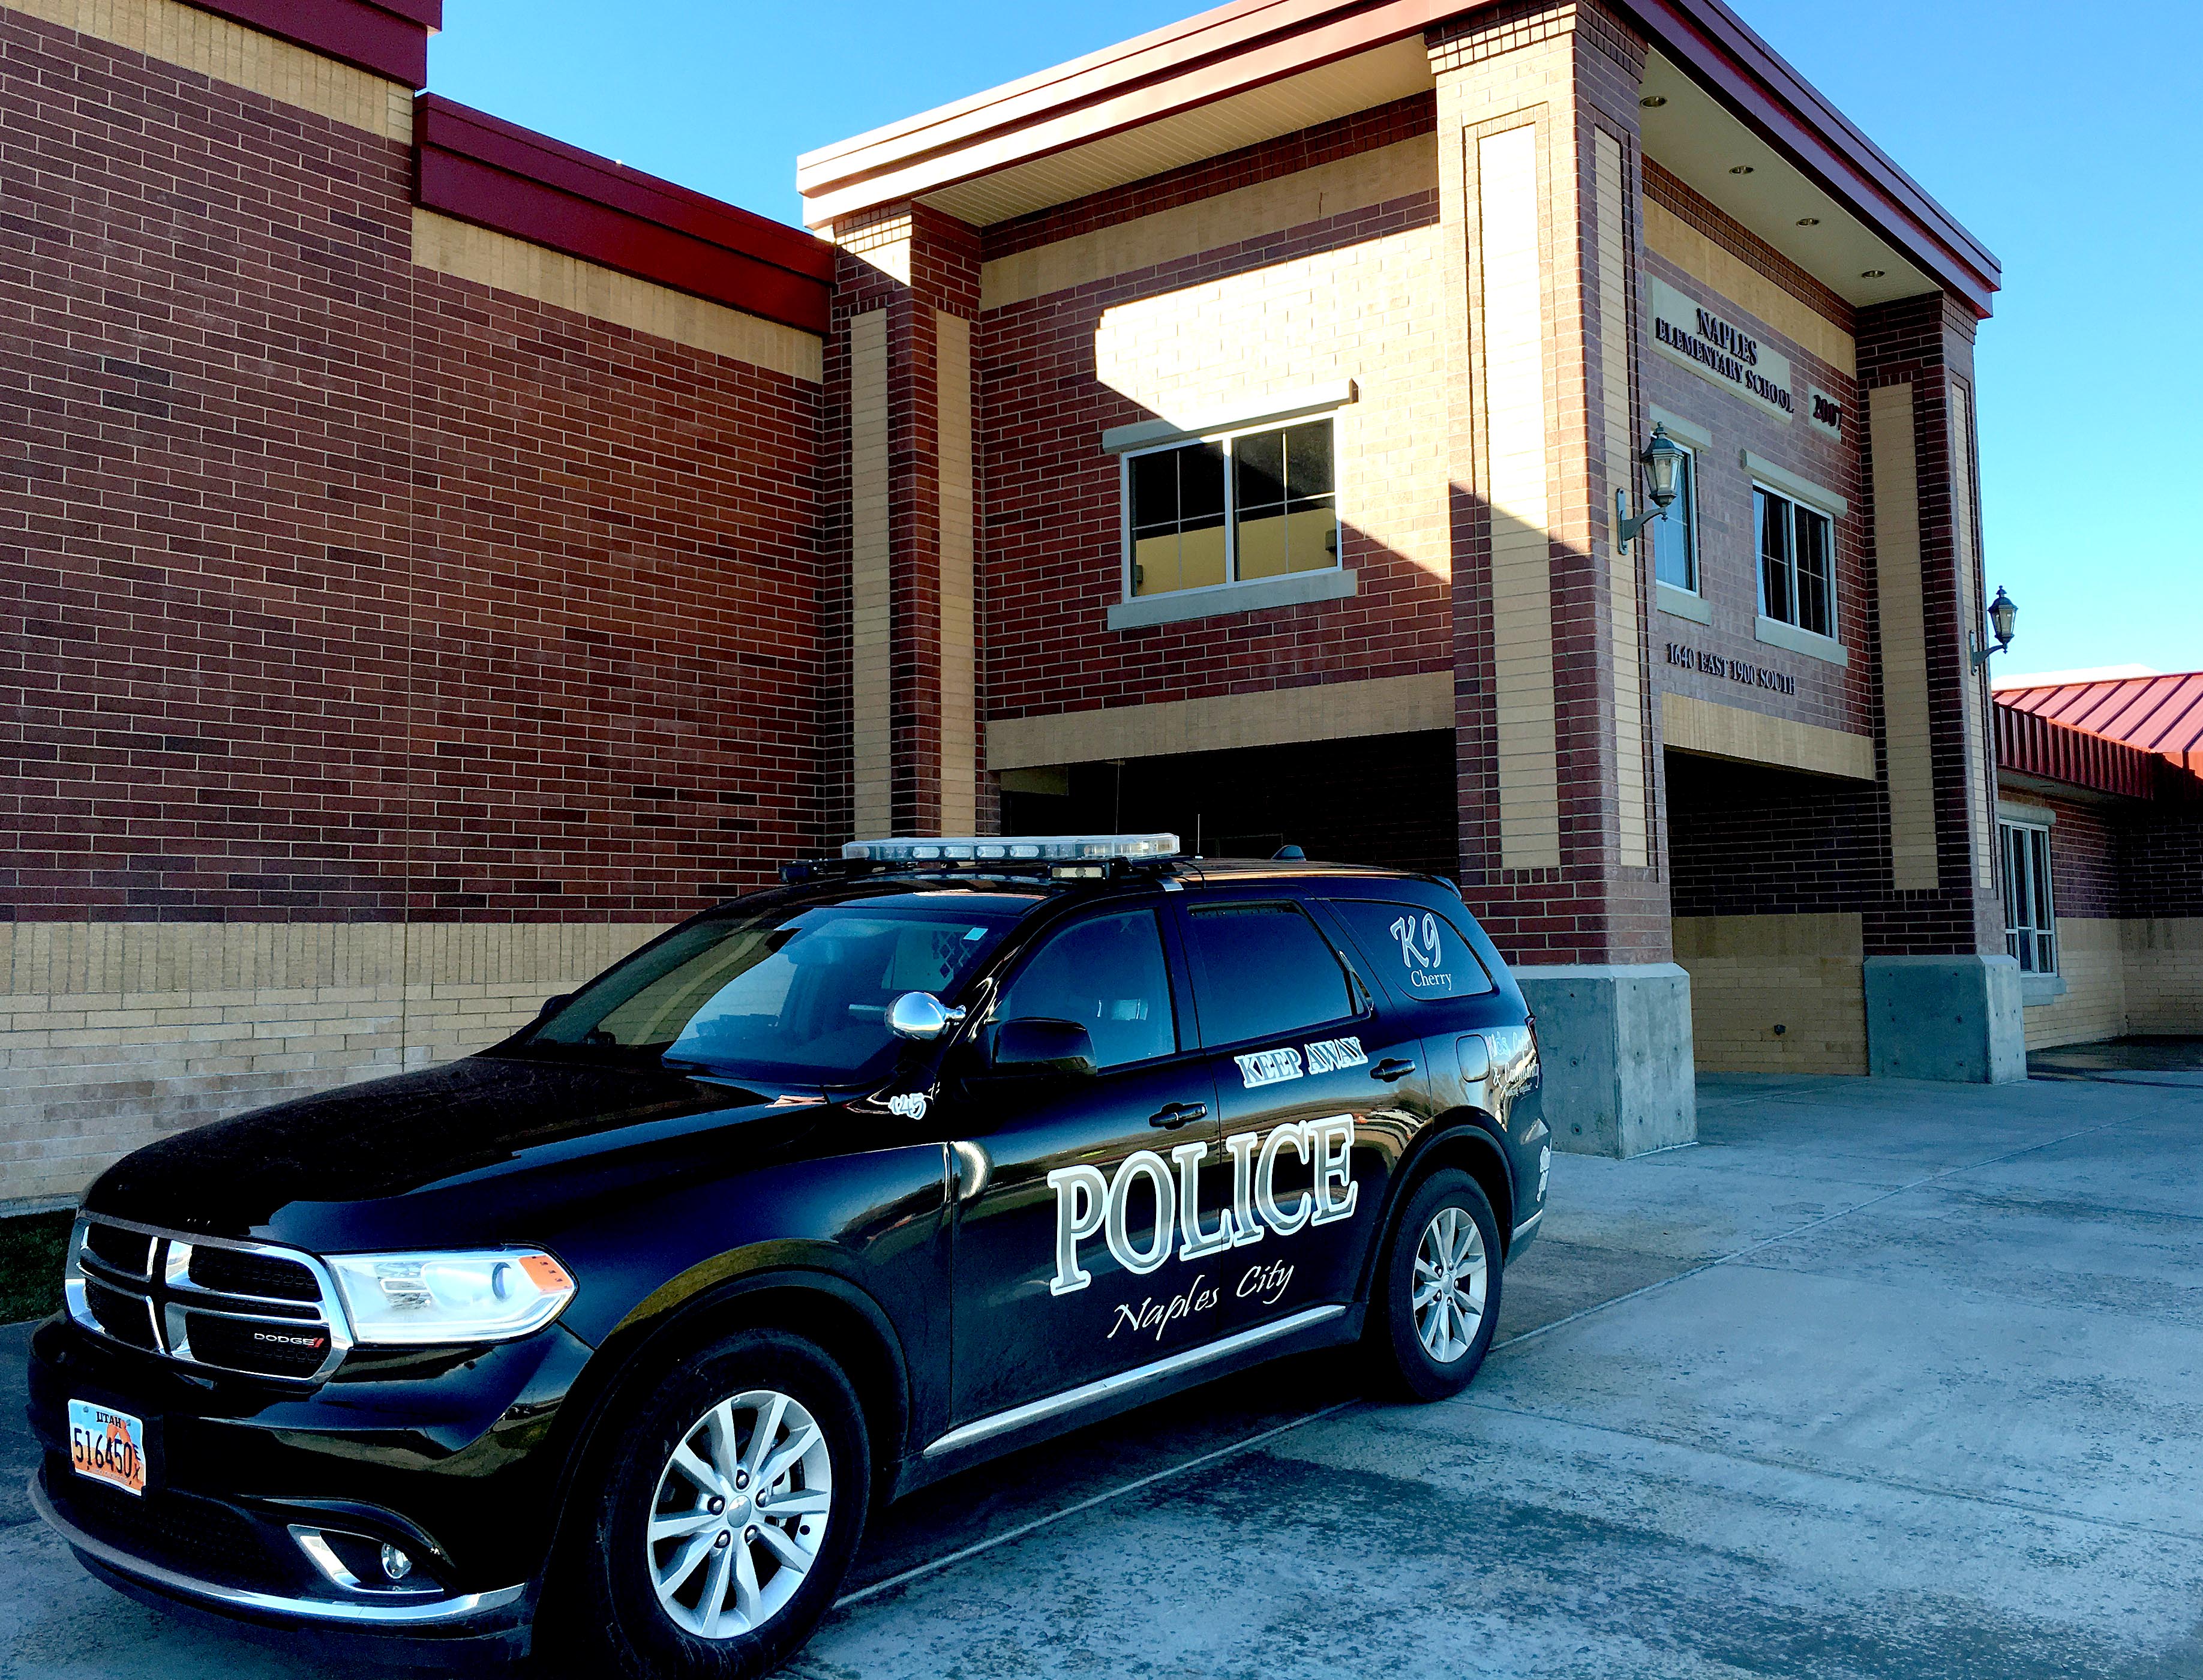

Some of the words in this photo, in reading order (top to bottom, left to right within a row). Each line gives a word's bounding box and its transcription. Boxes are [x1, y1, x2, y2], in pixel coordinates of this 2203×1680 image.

[1695, 307, 1758, 366] NAPLES
[1655, 317, 1743, 383] ELEMENTARY
[1745, 370, 1794, 414] SCHOOL
[1812, 394, 1843, 431] 2007
[1665, 642, 1694, 669] 1640
[1698, 650, 1728, 677] EAST
[1730, 660, 1757, 685] 1900
[1758, 667, 1796, 695] SOUTH
[1390, 912, 1441, 968] K9
[1410, 970, 1452, 991] Cherry
[1234, 1048, 1304, 1088] KEEP
[1308, 1036, 1368, 1075] AWAY
[888, 1093, 926, 1120] 145
[1047, 1113, 1358, 1296] POLICE
[1107, 1274, 1220, 1341] Naples
[1236, 1260, 1295, 1304] City
[254, 1333, 314, 1346] DODGE
[96, 1411, 121, 1429] UTAH
[74, 1427, 133, 1478] 516450
